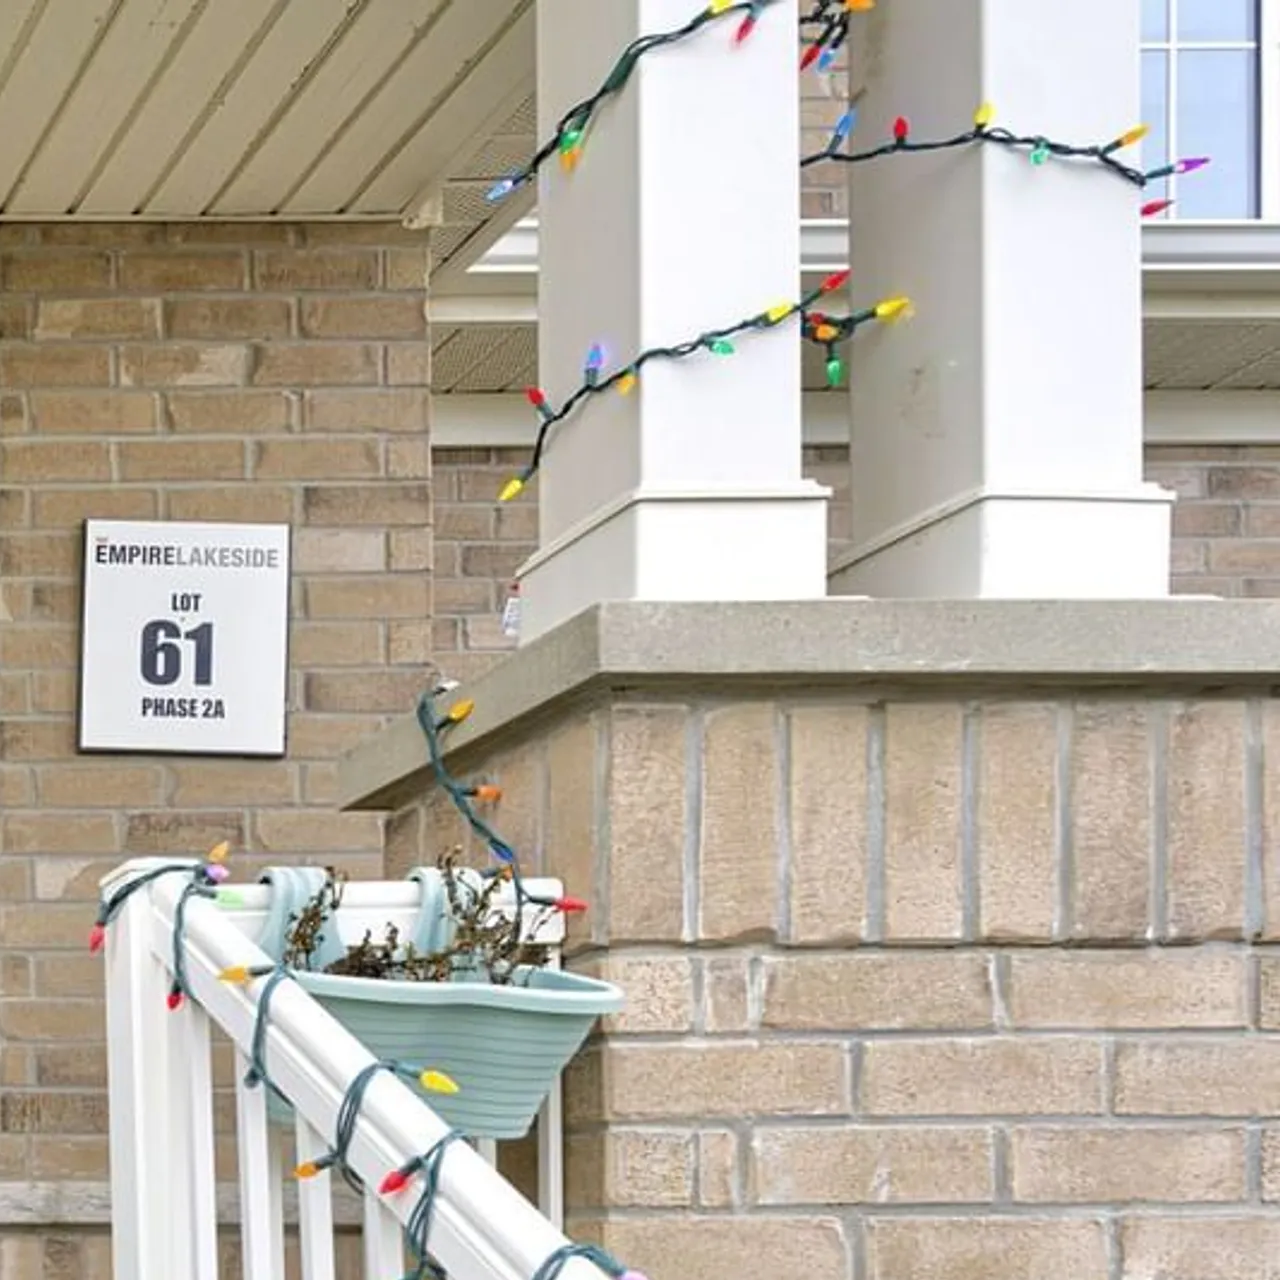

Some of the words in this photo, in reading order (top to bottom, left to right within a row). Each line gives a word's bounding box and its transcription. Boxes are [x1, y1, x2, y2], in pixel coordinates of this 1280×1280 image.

[171, 593, 202, 612] LOT
[140, 619, 213, 686] 61
[141, 697, 198, 717] PHASE
[202, 698, 225, 719] 2A
